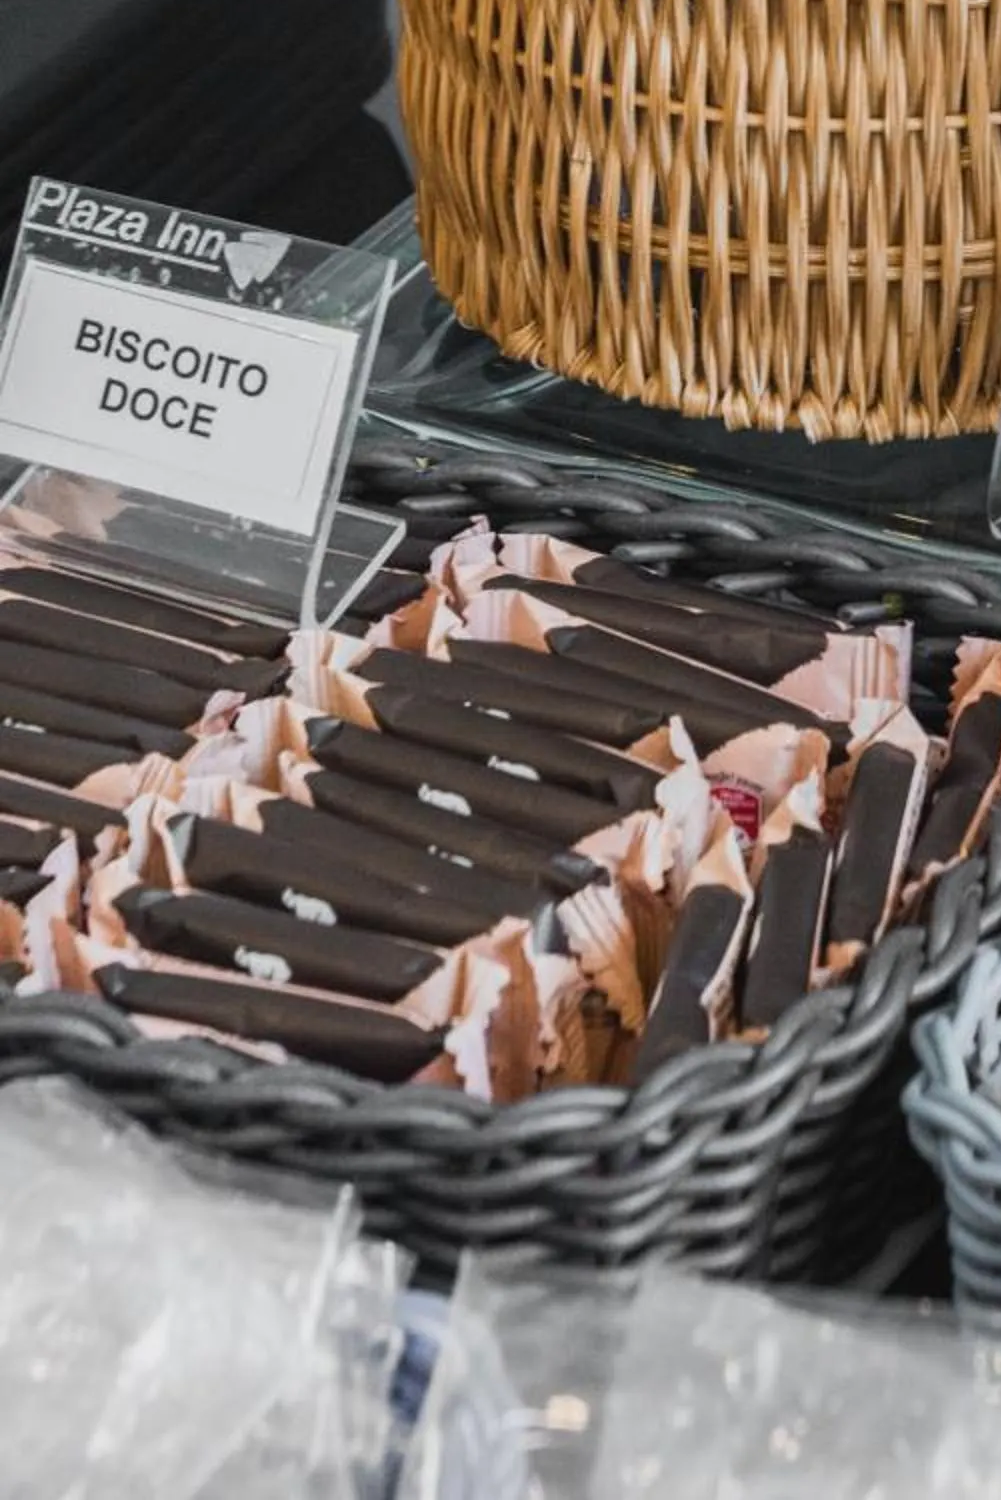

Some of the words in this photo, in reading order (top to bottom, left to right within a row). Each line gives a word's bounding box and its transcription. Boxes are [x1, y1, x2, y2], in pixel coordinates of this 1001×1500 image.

[26, 181, 149, 243] Plaza
[156, 211, 226, 260] Inn
[75, 319, 268, 397] BISCOITO
[99, 378, 217, 439] DOCE
